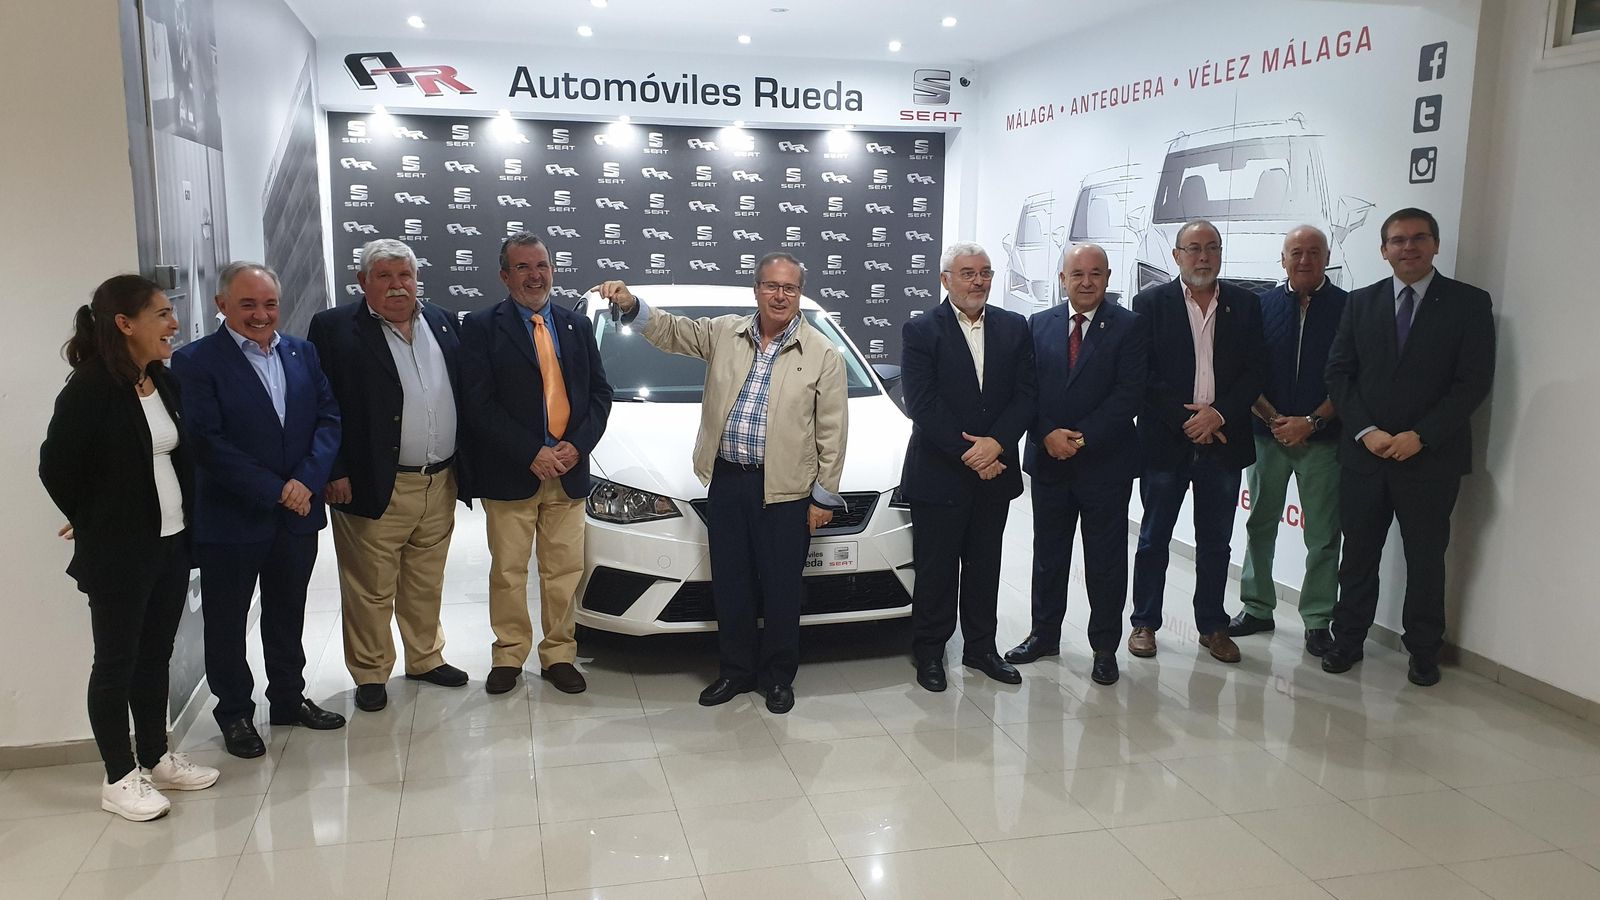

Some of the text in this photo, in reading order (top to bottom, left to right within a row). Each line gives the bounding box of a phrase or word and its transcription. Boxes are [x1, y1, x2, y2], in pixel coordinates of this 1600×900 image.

[508, 65, 864, 112] Automóviles Rueda
[1006, 26, 1373, 131] MÁLAGA ANTEQUERA VÉLEZ MÁLAGA
[899, 110, 962, 123] SEAT
